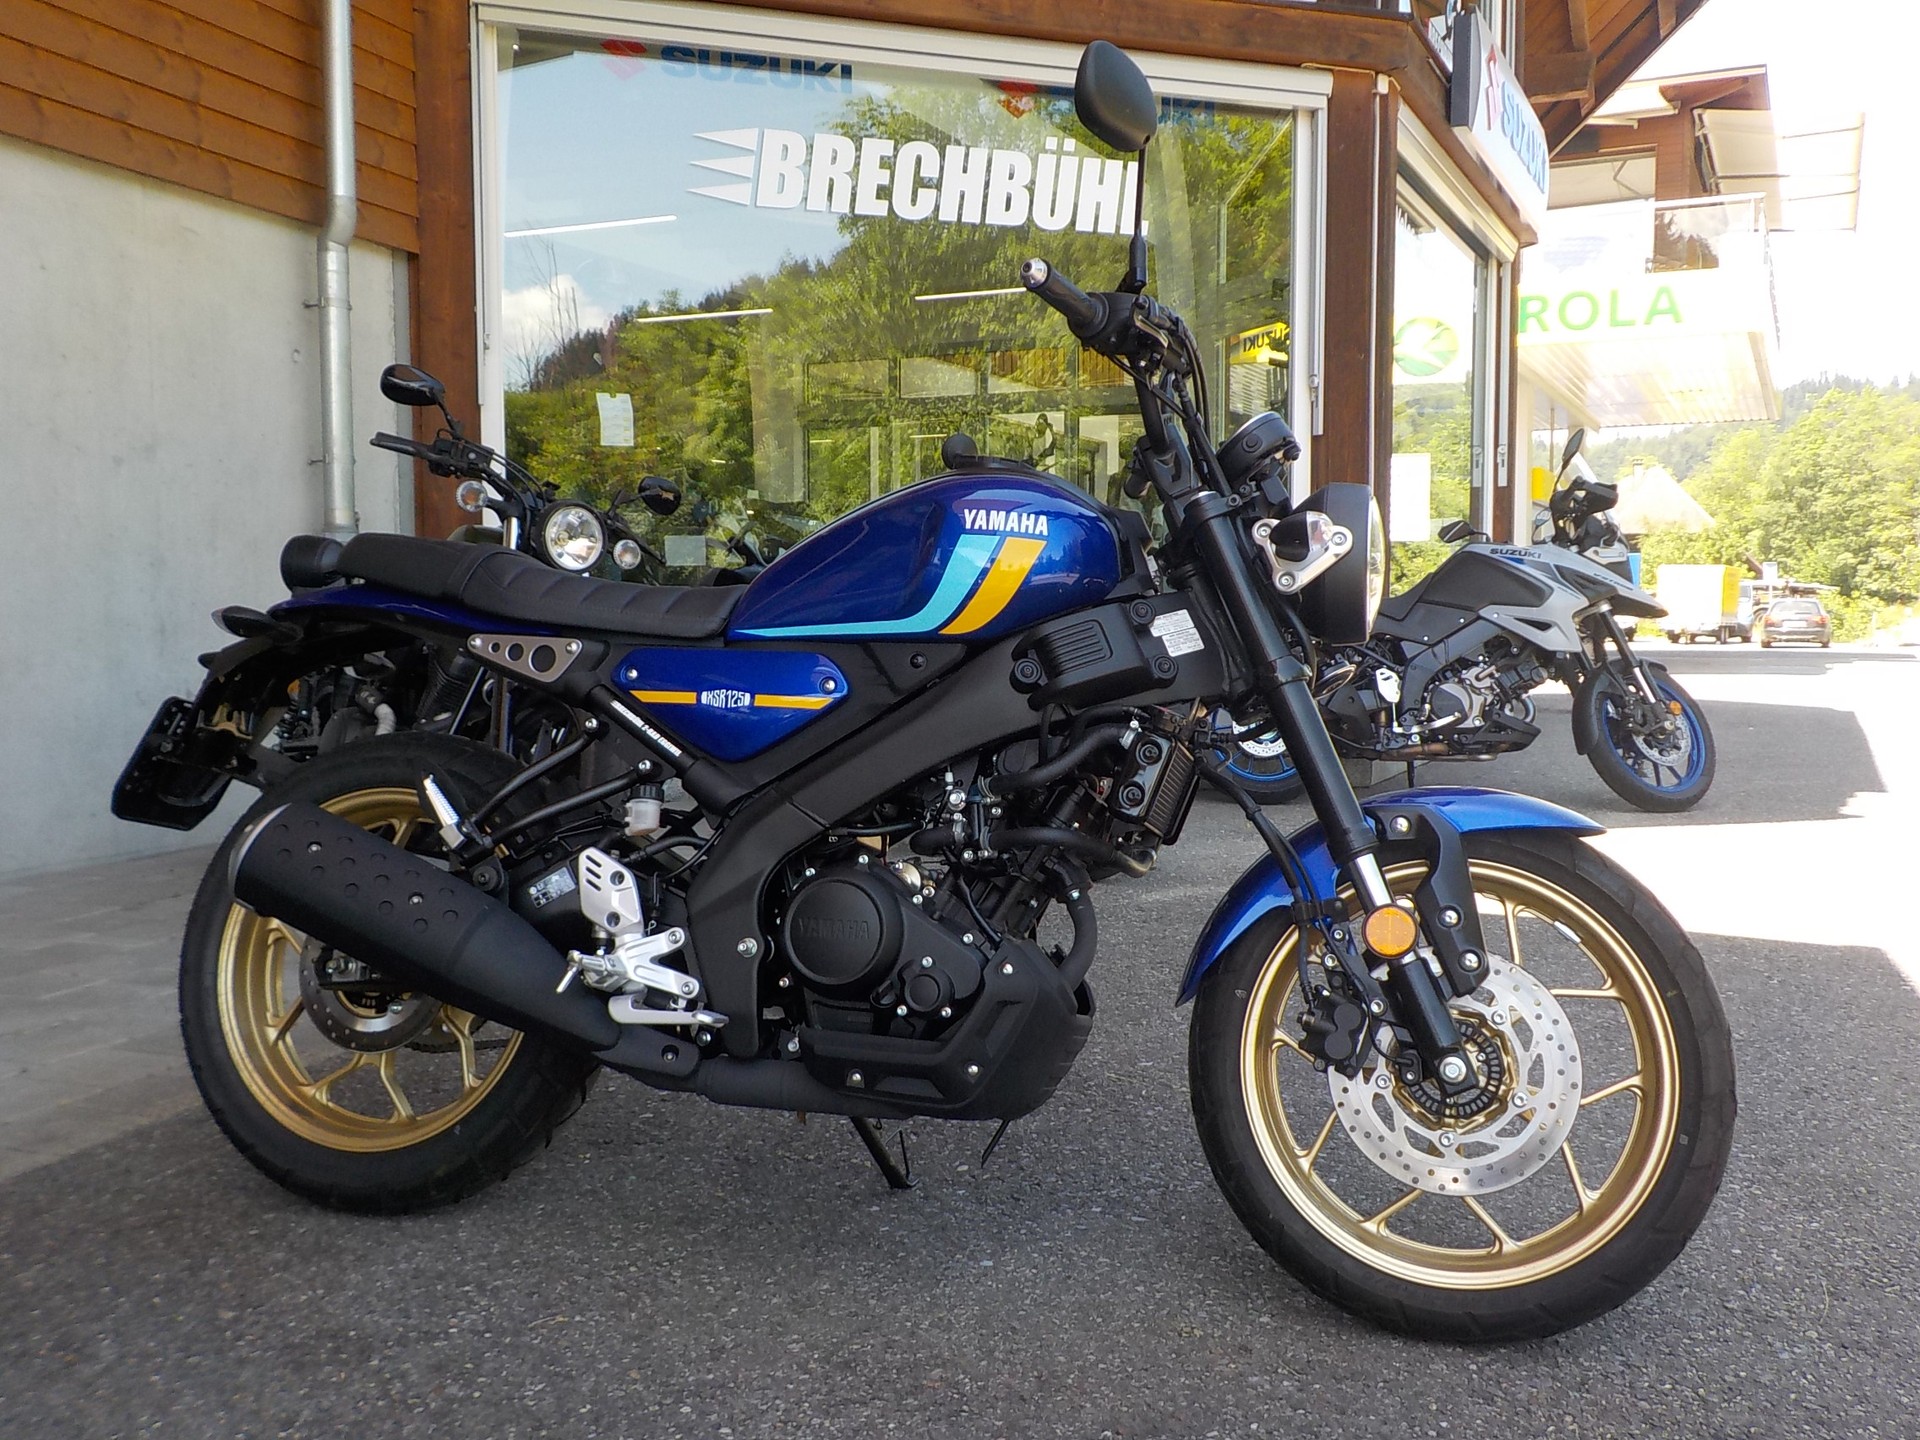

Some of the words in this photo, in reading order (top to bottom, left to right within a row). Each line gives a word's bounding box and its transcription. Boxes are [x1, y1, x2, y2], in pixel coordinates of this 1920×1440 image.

[661, 45, 853, 94] SUZUKI
[1501, 81, 1547, 195] SUZUKI
[964, 509, 1048, 536] YAMAHA
[1489, 548, 1541, 559] SUZUKI
[706, 689, 746, 709] XSR125
[799, 919, 869, 939] YAMAHA
